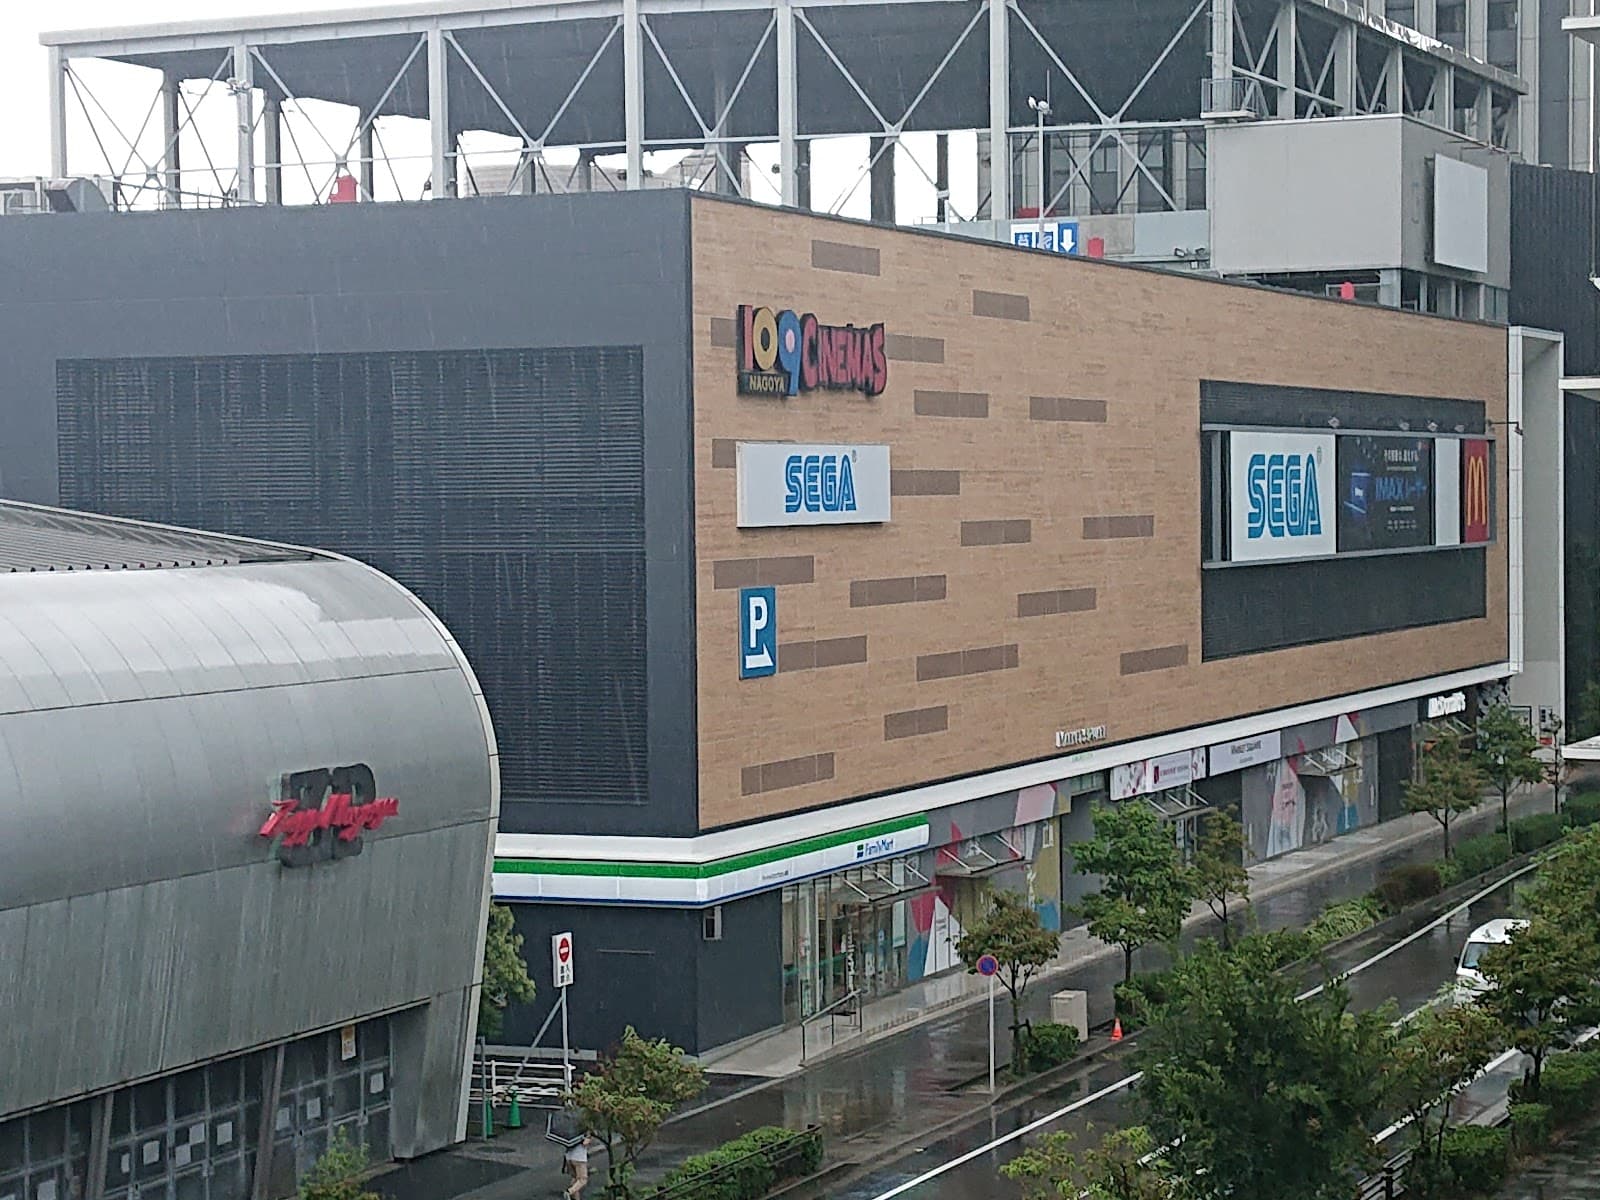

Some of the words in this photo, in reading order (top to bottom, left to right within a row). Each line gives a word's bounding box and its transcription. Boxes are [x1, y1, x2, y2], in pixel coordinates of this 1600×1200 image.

[736, 304, 801, 396] 109
[799, 313, 887, 396] CINEMAS
[749, 375, 785, 393] NAGOYA
[785, 455, 856, 513] SEGA
[1247, 453, 1322, 539] SEGA
[749, 596, 768, 648] P
